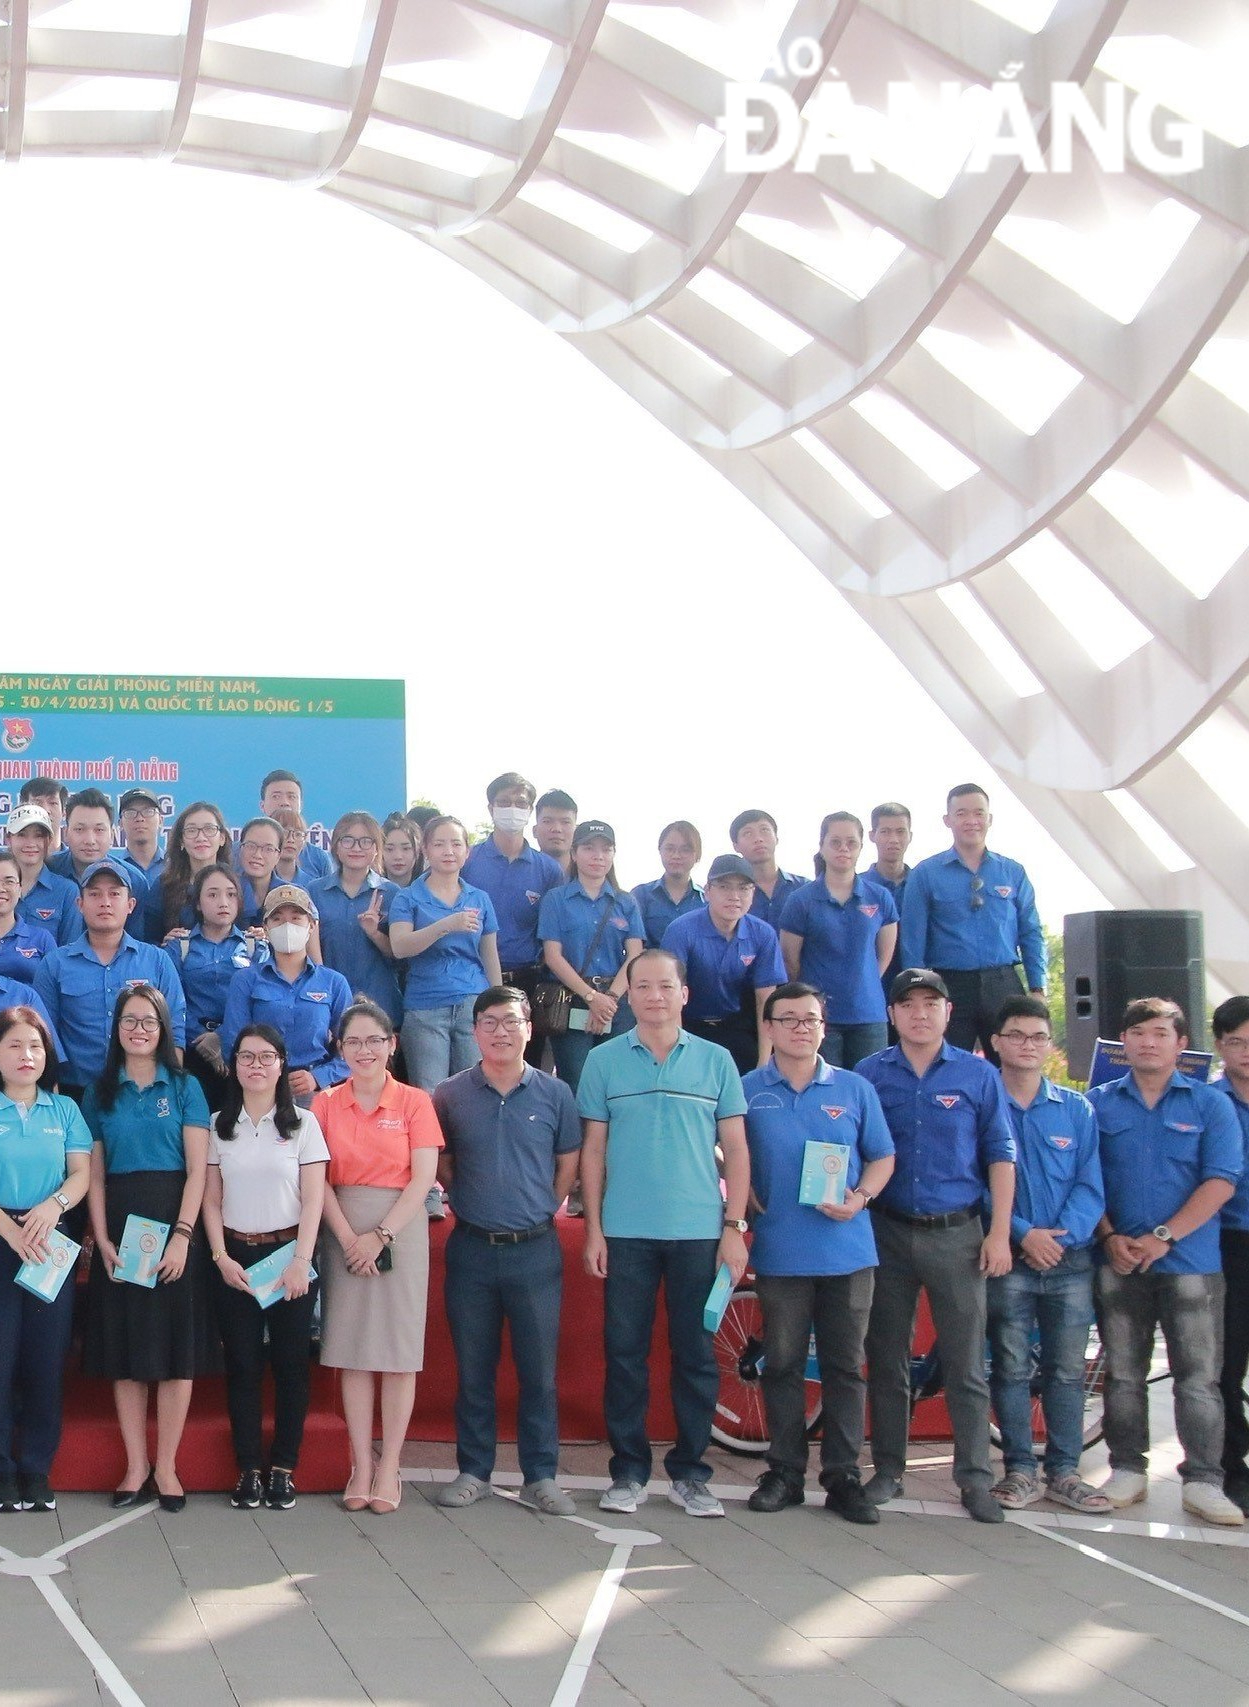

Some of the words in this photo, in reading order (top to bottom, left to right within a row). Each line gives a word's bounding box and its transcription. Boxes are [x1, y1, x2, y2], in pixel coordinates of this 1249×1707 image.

[27, 675, 71, 691] NGÀY
[114, 676, 171, 692] PHÓNG
[176, 677, 215, 693] MIỀN
[219, 680, 261, 695] NAM,
[20, 695, 114, 713] 30/4/2023)
[118, 695, 140, 710] VÀ
[144, 695, 192, 711] QUỐC
[196, 694, 215, 711] TẾ
[218, 699, 249, 712] LAO
[253, 697, 300, 714] ĐỘNG
[307, 700, 334, 713] 1/5
[36, 758, 81, 780] THÀNH
[85, 756, 112, 780] PHỐ
[117, 758, 136, 781] ĐÀ
